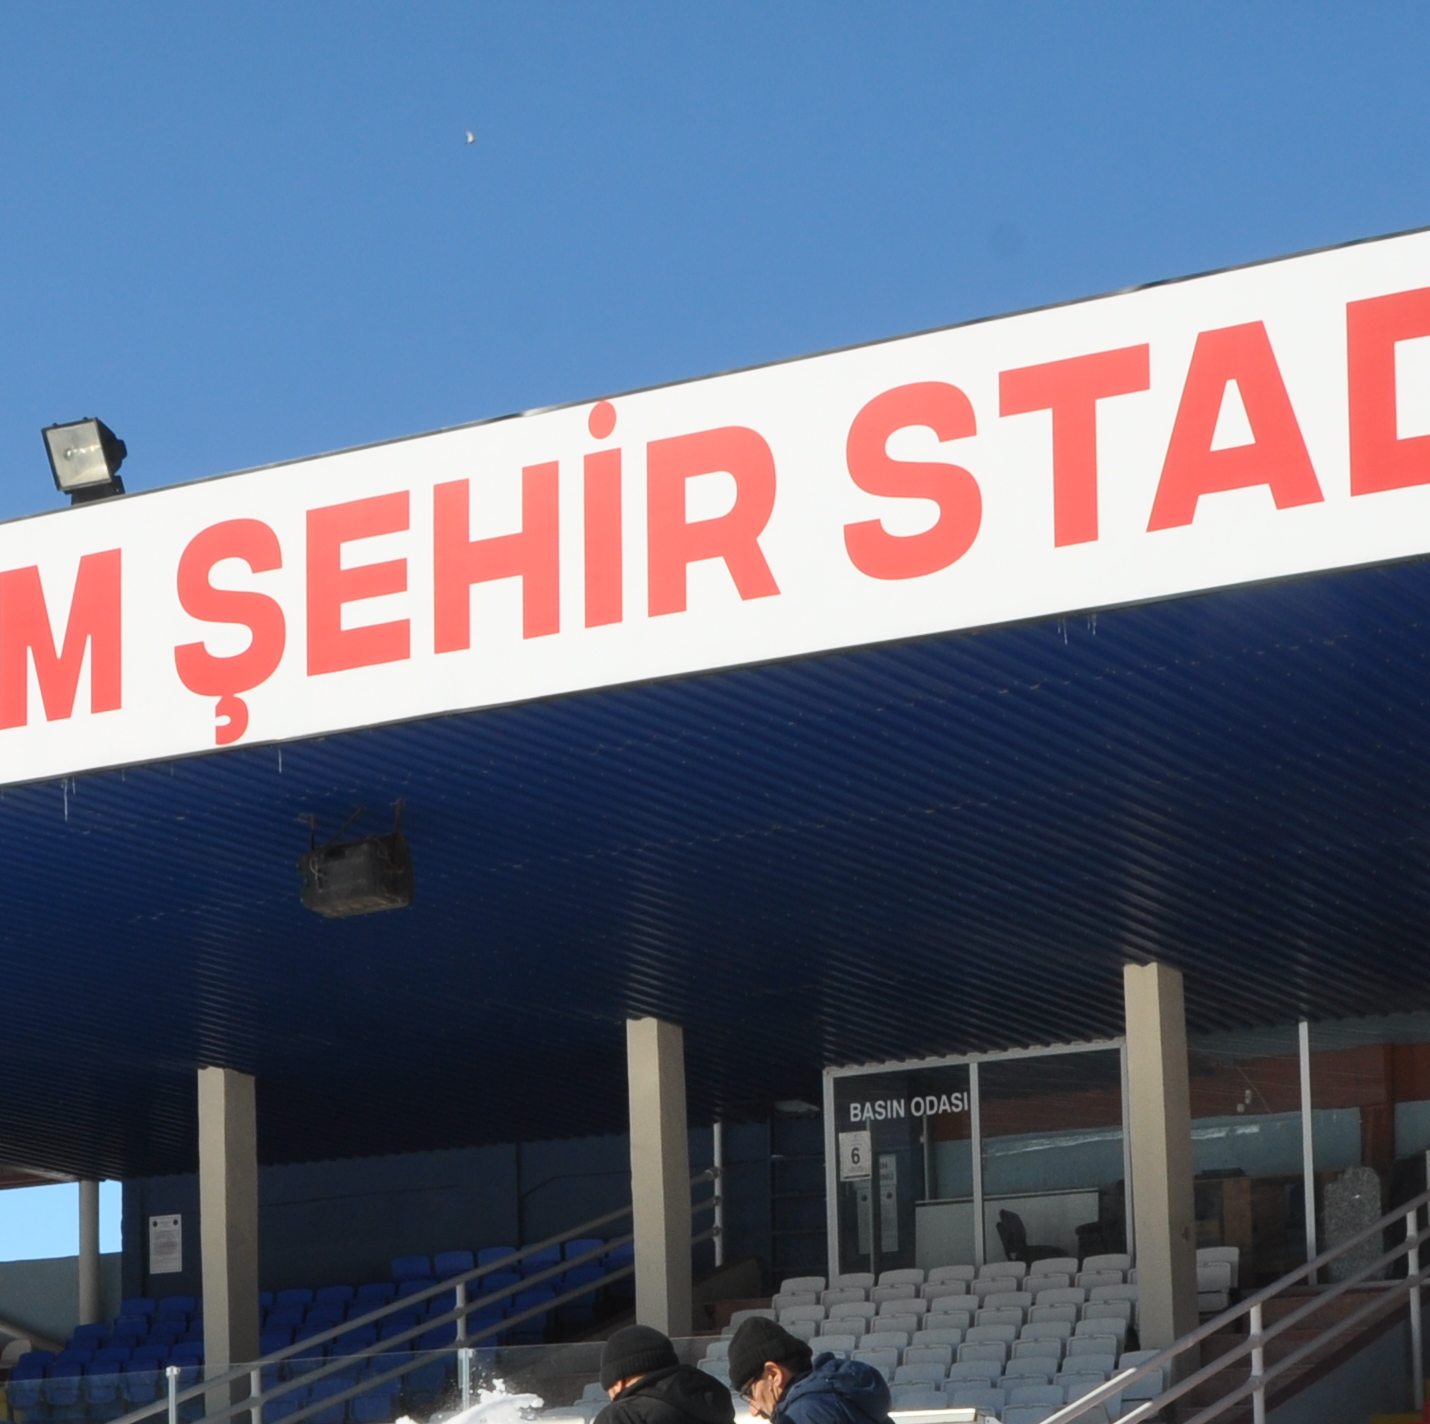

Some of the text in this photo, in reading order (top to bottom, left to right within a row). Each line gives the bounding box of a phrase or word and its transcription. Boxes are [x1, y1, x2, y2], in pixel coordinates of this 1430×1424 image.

[175, 400, 780, 745] ŞEHİR
[850, 1092, 968, 1122] BASIN ODASI
[851, 1147, 860, 1165] 6
